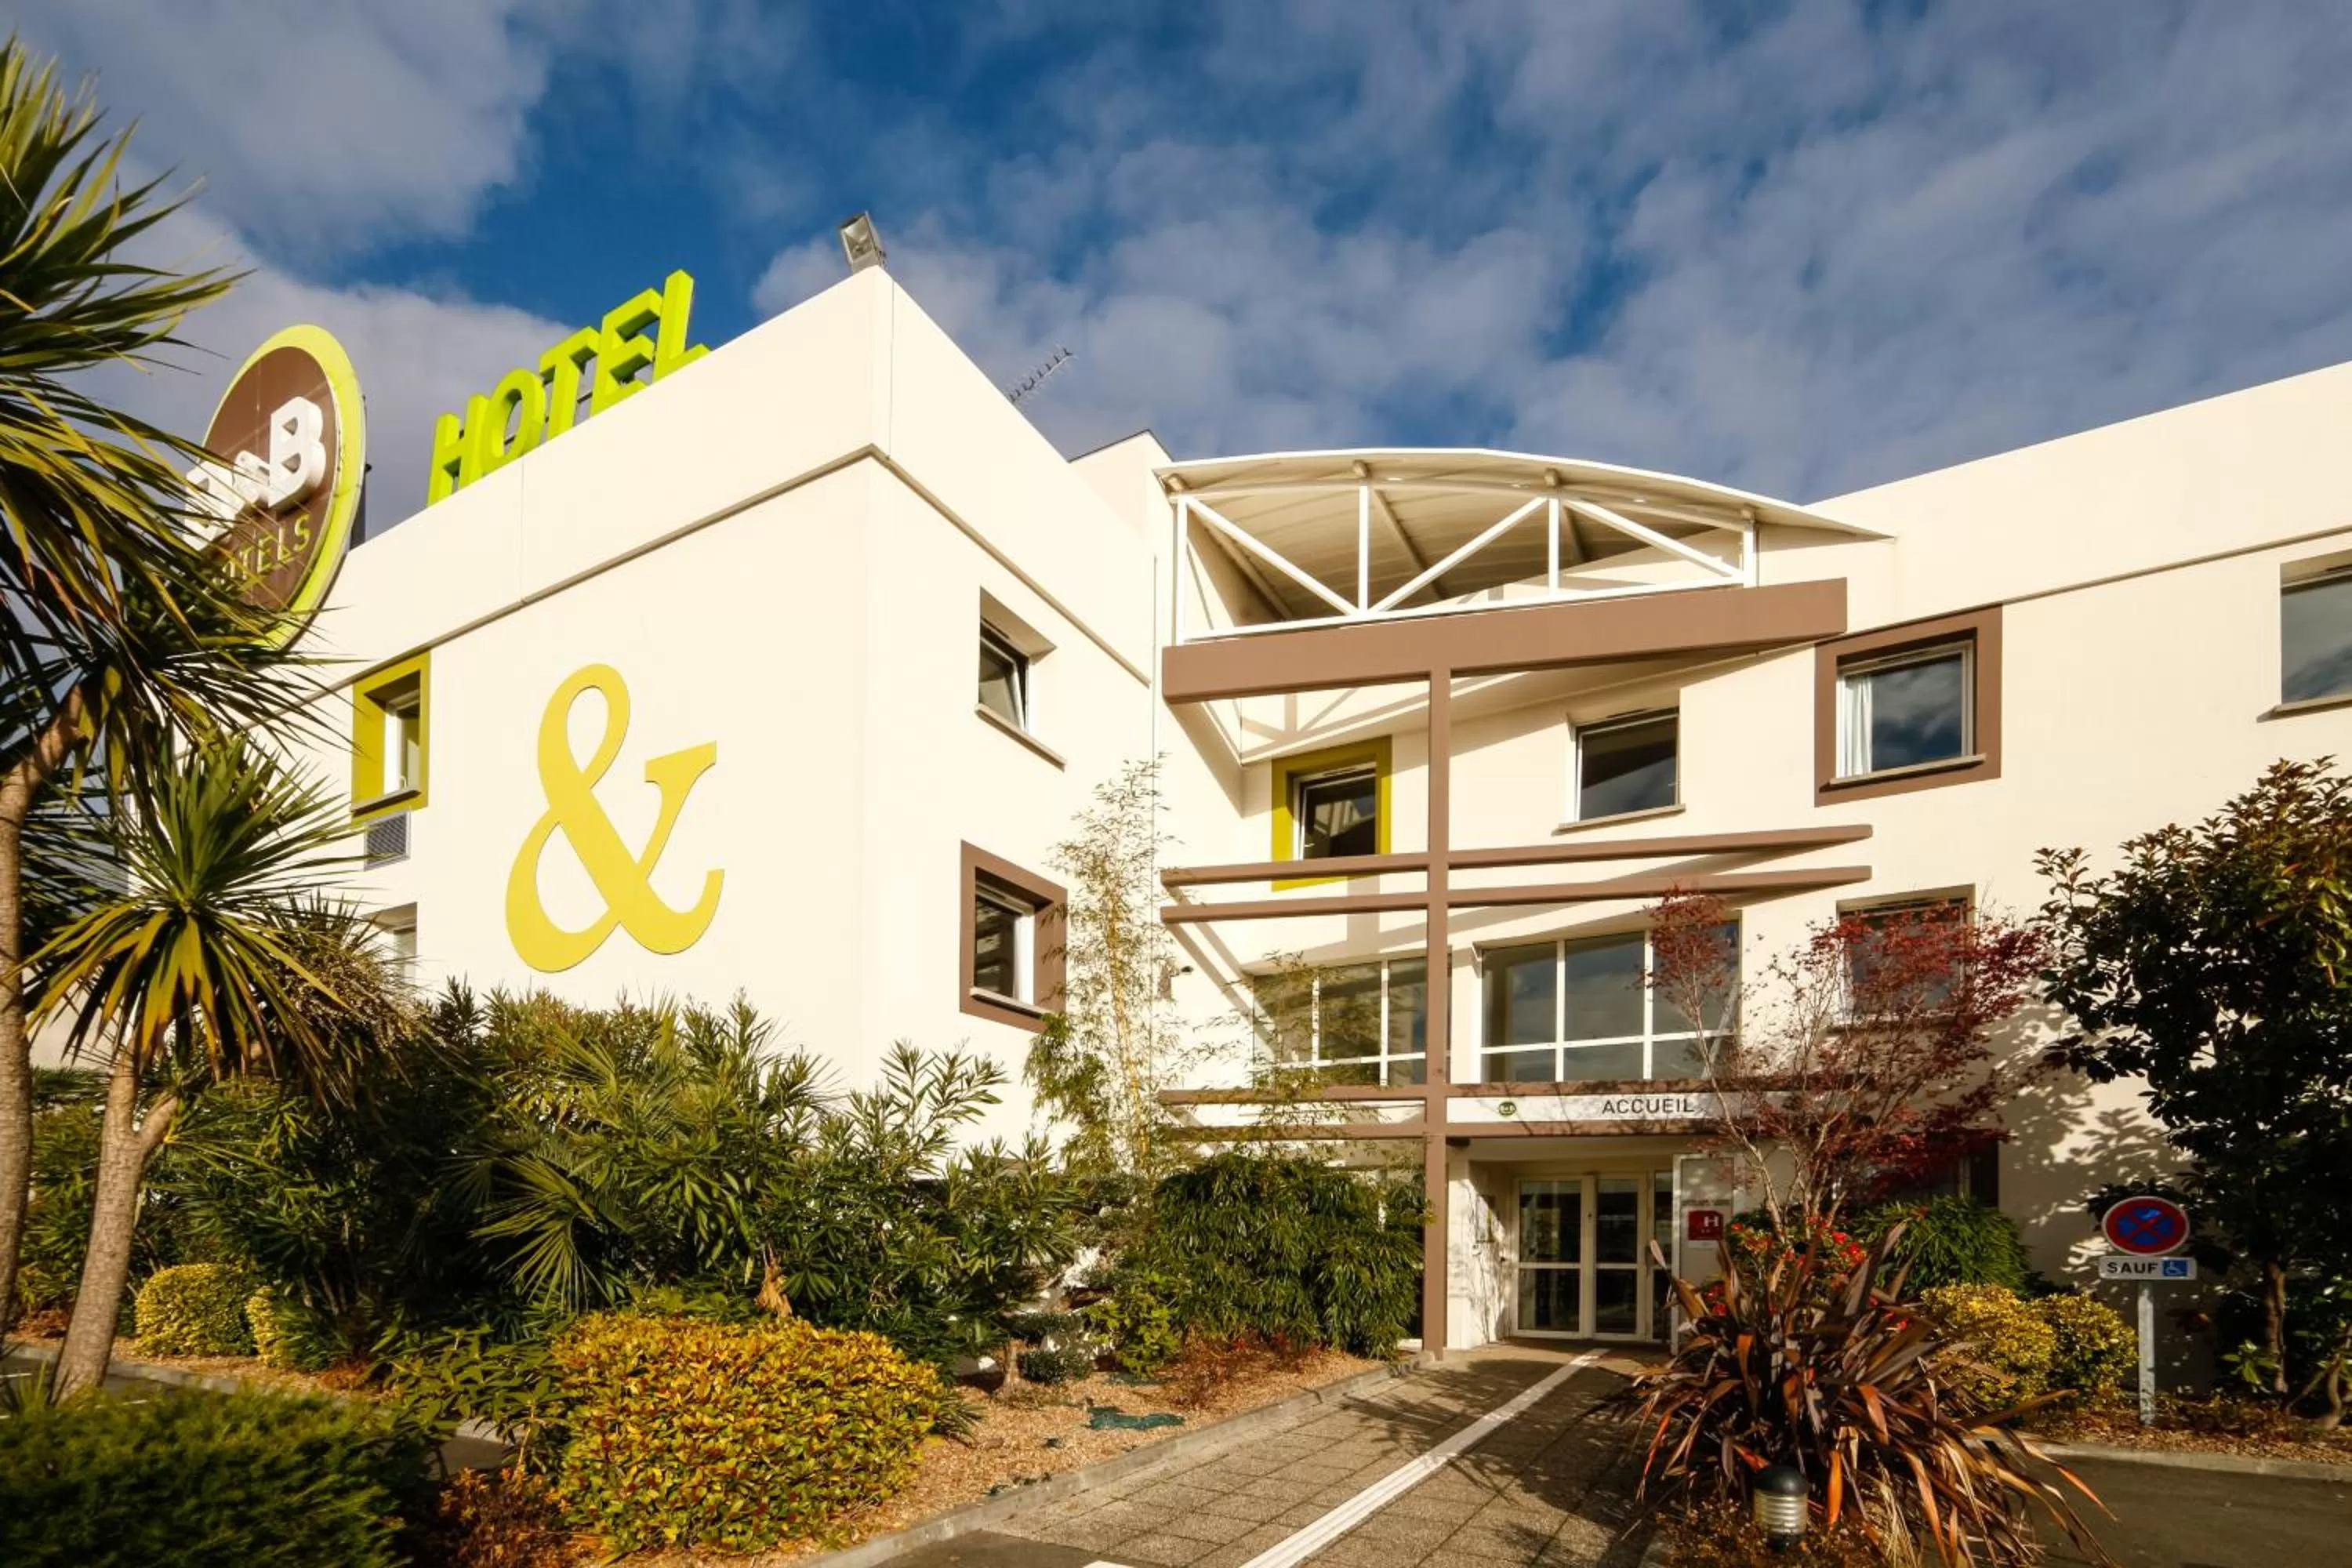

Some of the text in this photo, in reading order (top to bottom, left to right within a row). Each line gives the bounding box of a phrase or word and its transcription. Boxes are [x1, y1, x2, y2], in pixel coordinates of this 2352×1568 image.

[427, 269, 710, 506] HOTEL
[506, 663, 724, 974] &
[1602, 1098, 1695, 1114] ACCUEIL
[1704, 1216, 1719, 1227] H
[2107, 1261, 2158, 1274] SAUF
